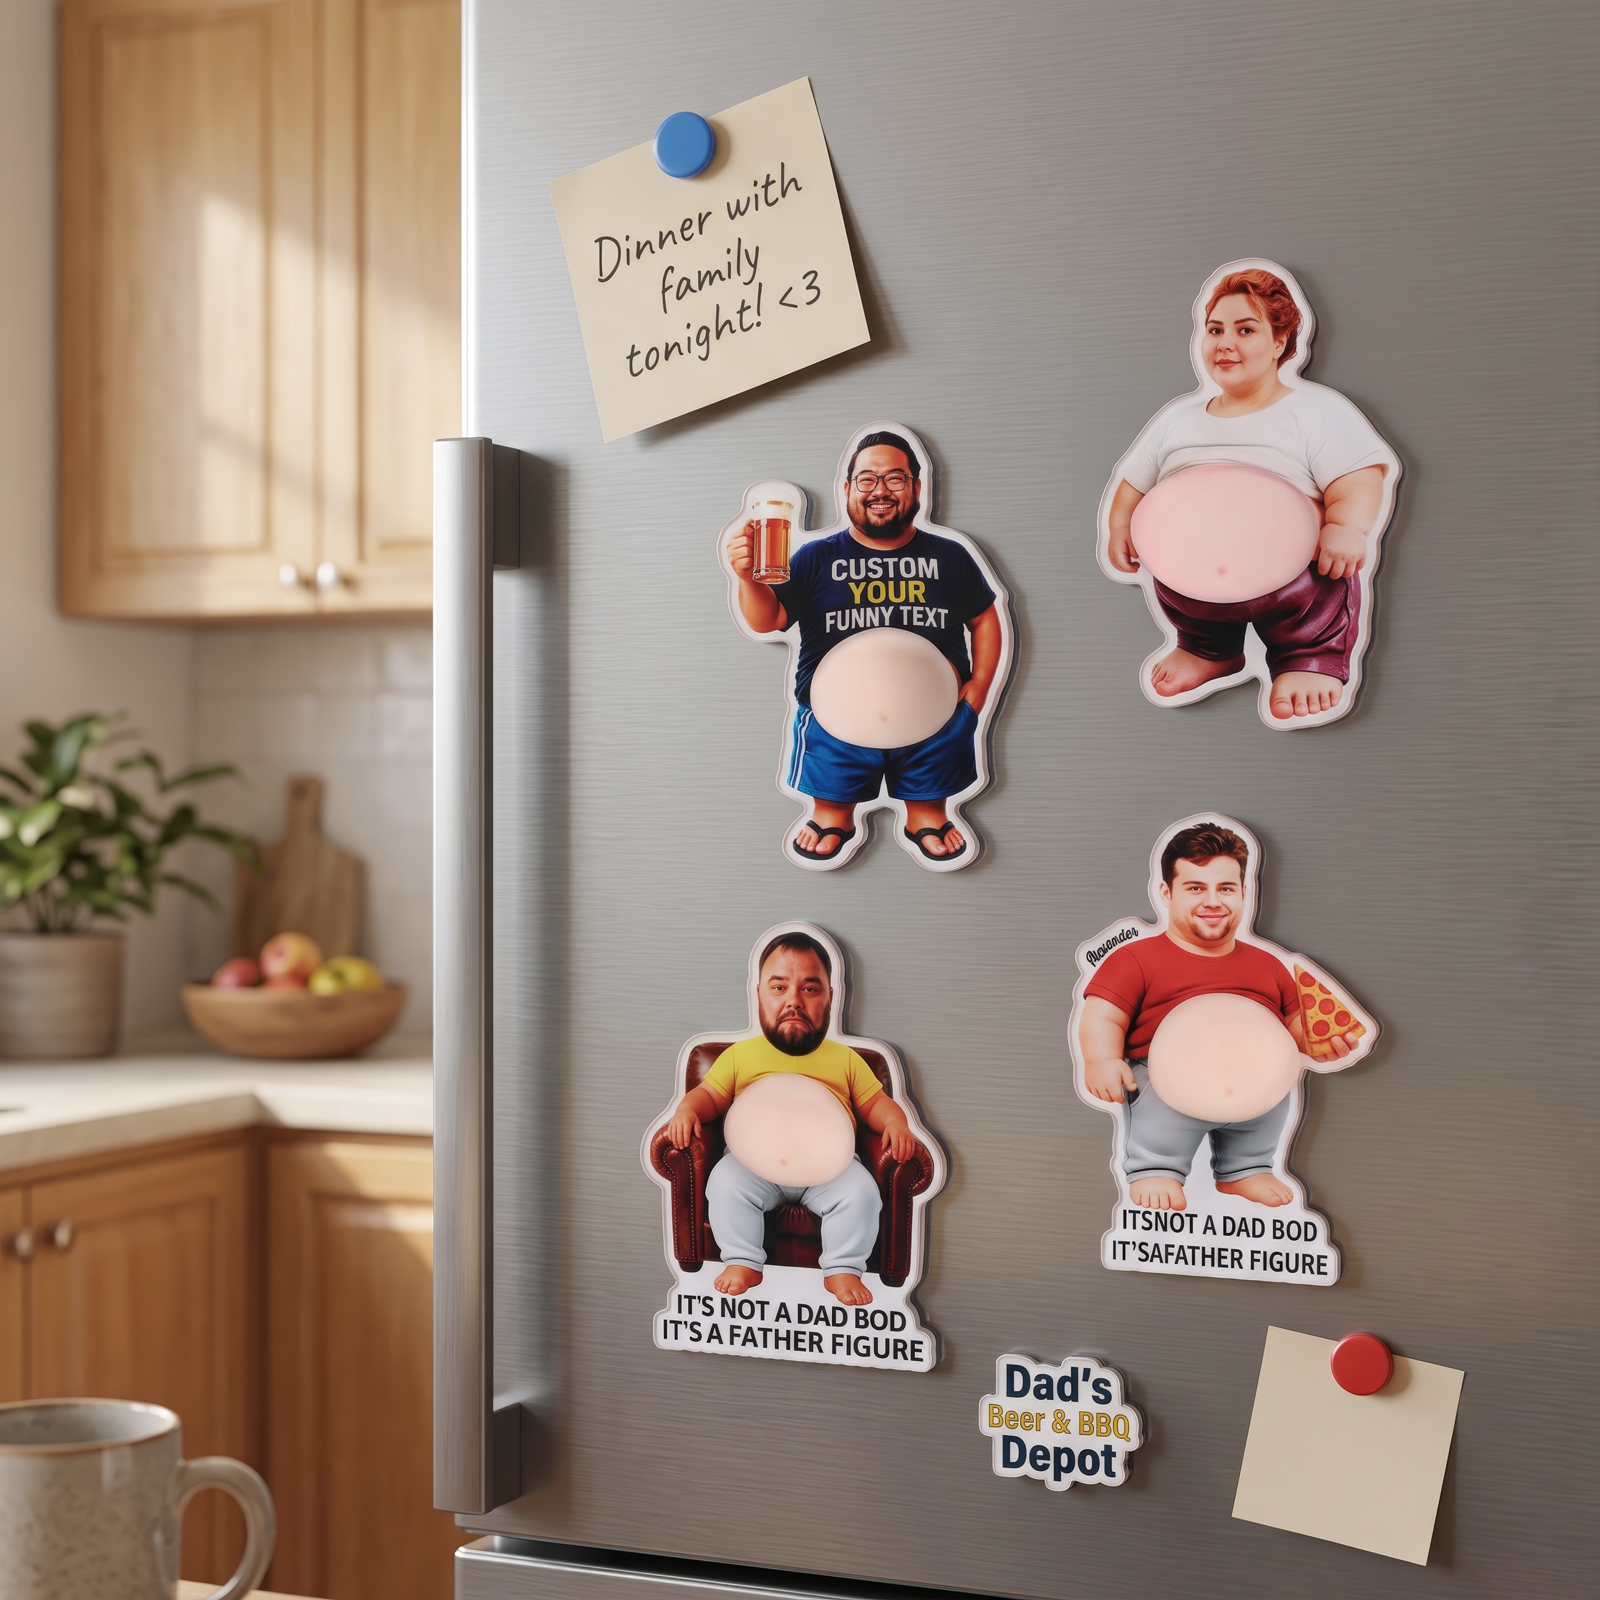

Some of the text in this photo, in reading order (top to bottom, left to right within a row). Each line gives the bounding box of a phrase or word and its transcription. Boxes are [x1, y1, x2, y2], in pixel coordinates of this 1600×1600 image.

[594, 162, 802, 282] Dinner with
[661, 237, 760, 314] family
[626, 282, 763, 378] tonight!
[831, 557, 940, 581] CUSTOM
[848, 580, 926, 604] YOUR
[825, 605, 949, 633] FUNNY TEXT
[1202, 1214, 1217, 1235] A
[1222, 1215, 1266, 1239] DAD
[1272, 1219, 1318, 1242] BOD
[1250, 1249, 1329, 1276] FIGURE
[720, 1298, 770, 1321] NOT
[774, 1302, 792, 1323] A
[797, 1304, 848, 1328] DAD
[854, 1308, 907, 1332] BOD
[706, 1324, 724, 1344] A
[729, 1325, 824, 1354] FATHER
[831, 1333, 924, 1362] FIGURE
[1006, 1363, 1113, 1405] Dad's
[988, 1403, 1131, 1442] Beer & BBQ
[1002, 1434, 1117, 1482] Depot
